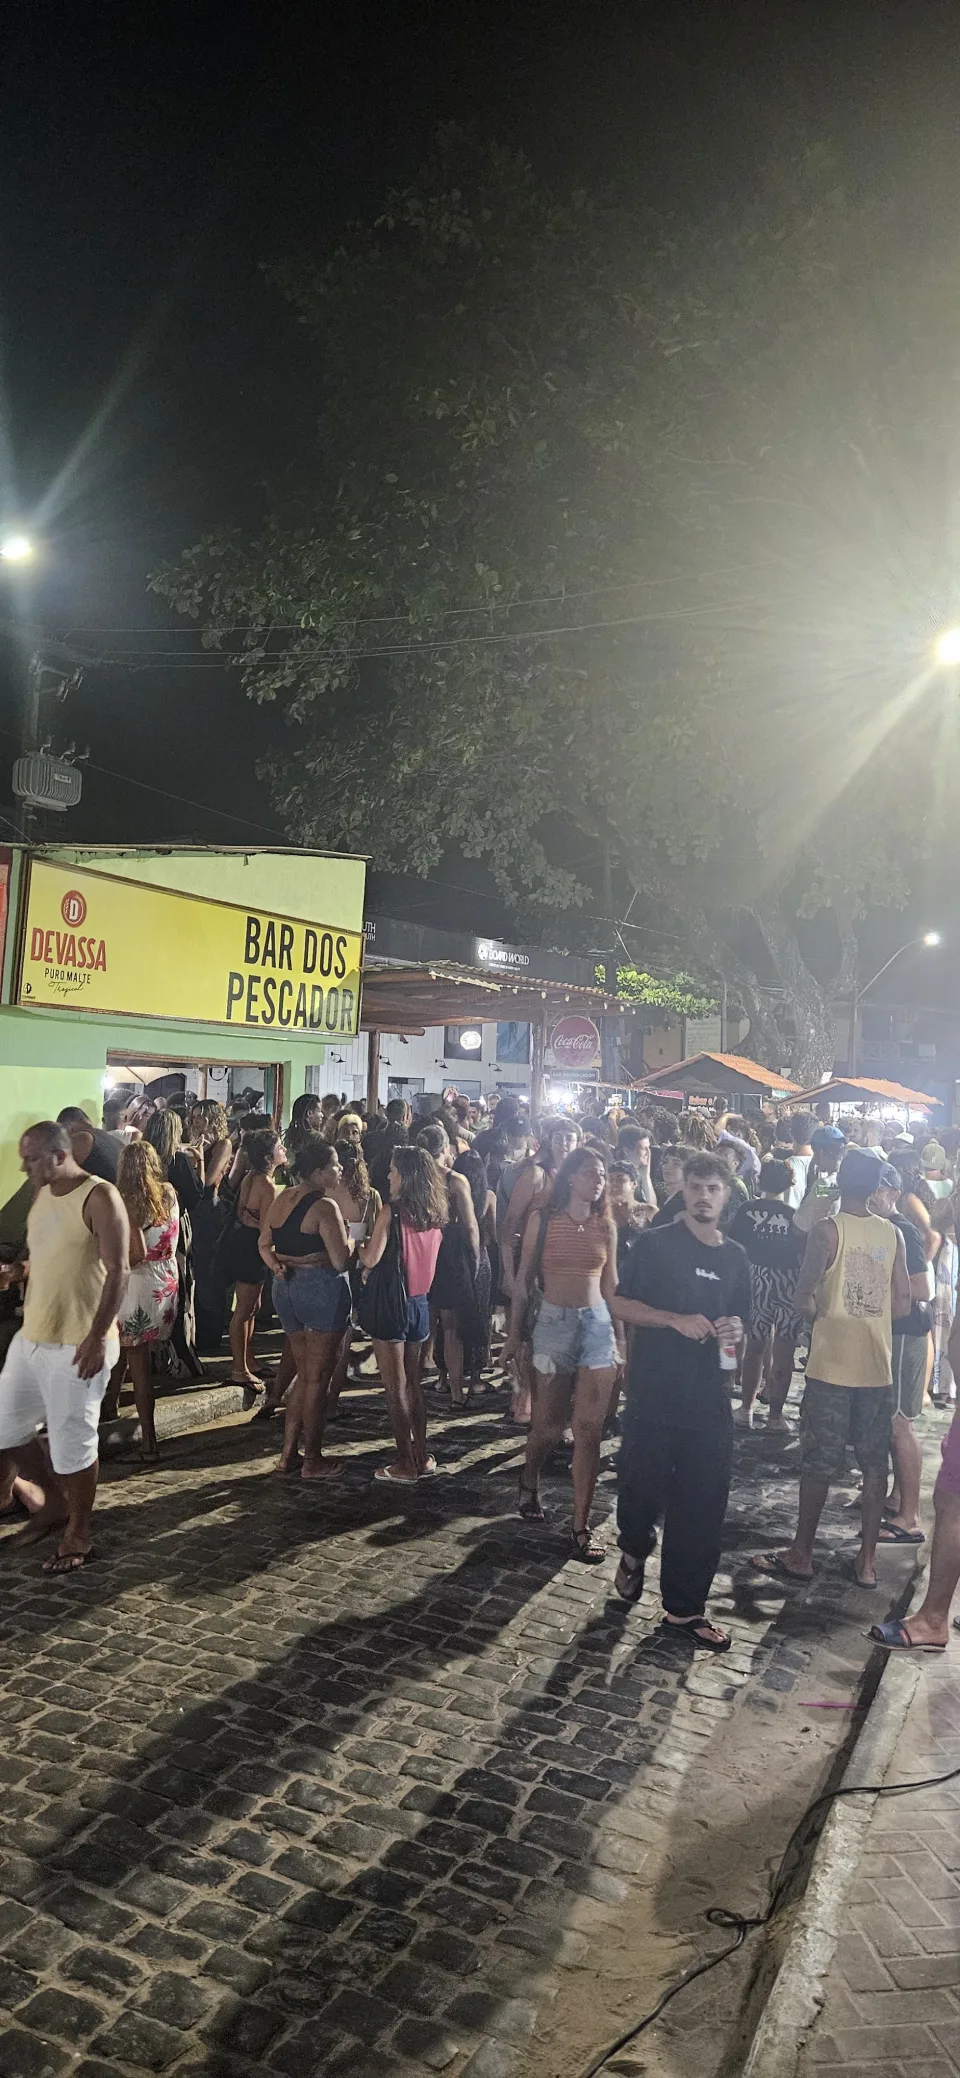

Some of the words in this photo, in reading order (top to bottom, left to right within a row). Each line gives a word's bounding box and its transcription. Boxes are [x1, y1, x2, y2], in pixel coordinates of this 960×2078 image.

[363, 921, 376, 934] UTH
[30, 927, 106, 972] DEVASSA
[244, 916, 294, 971] BAR
[303, 928, 347, 979] DOS
[488, 949, 508, 962] BOARD
[508, 952, 530, 966] WORLD
[44, 968, 64, 980] PURO
[66, 971, 91, 984] MALTE
[226, 971, 354, 1031] PESCADOR
